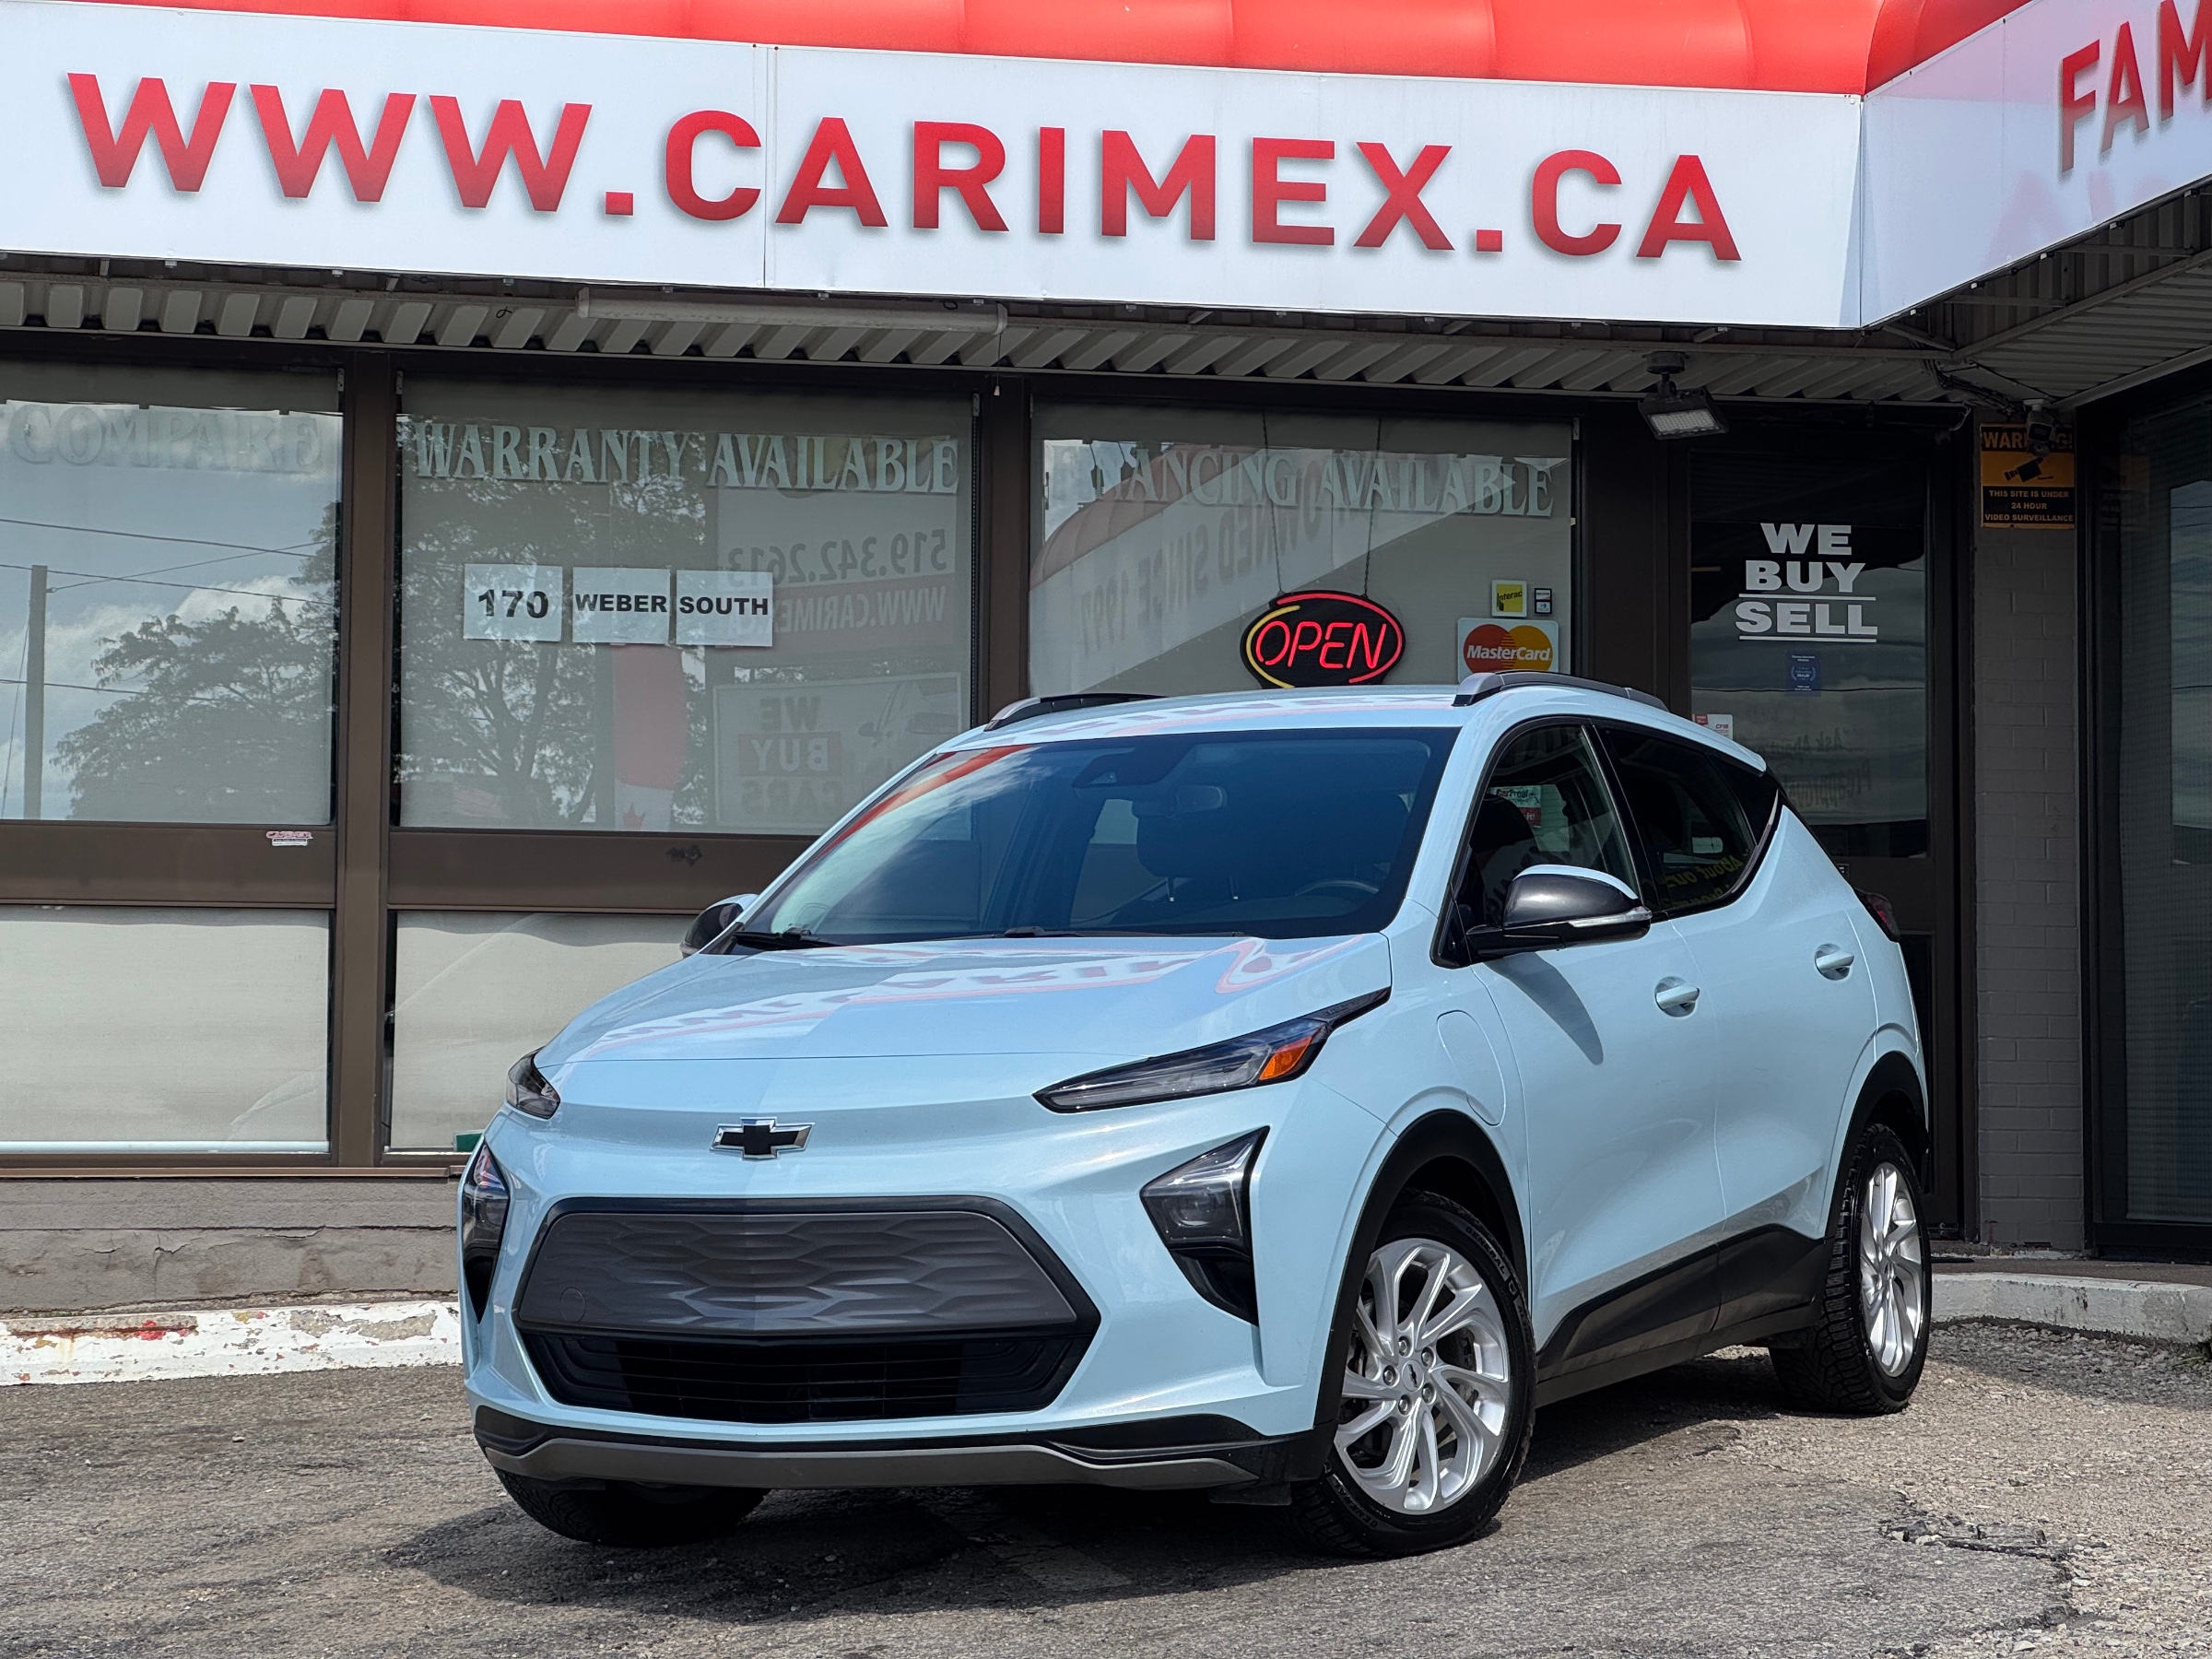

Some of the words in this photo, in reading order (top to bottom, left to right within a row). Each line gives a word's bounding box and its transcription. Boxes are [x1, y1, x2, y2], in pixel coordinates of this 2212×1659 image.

[67, 73, 1741, 262] WWW.CARIMEX.CA
[7, 404, 326, 473] COMPARE
[1983, 431, 2073, 449] WARG!
[415, 422, 690, 484] WARRANTY
[707, 433, 959, 493] AVAILABLE
[1320, 454, 1554, 517] AVAILABLE
[1984, 513, 2010, 522] VIDEO
[2011, 513, 2074, 523] SURVEILLANCE
[1760, 523, 1852, 555] WE
[1746, 559, 1865, 593] BUY
[478, 590, 548, 618] 170
[575, 594, 667, 613] WEBER
[678, 596, 768, 615] SOUTH
[1497, 591, 1524, 602] Interac
[1735, 601, 1877, 635] SELL
[1255, 620, 1387, 669] OPEN
[1466, 645, 1551, 661] MasterCard
